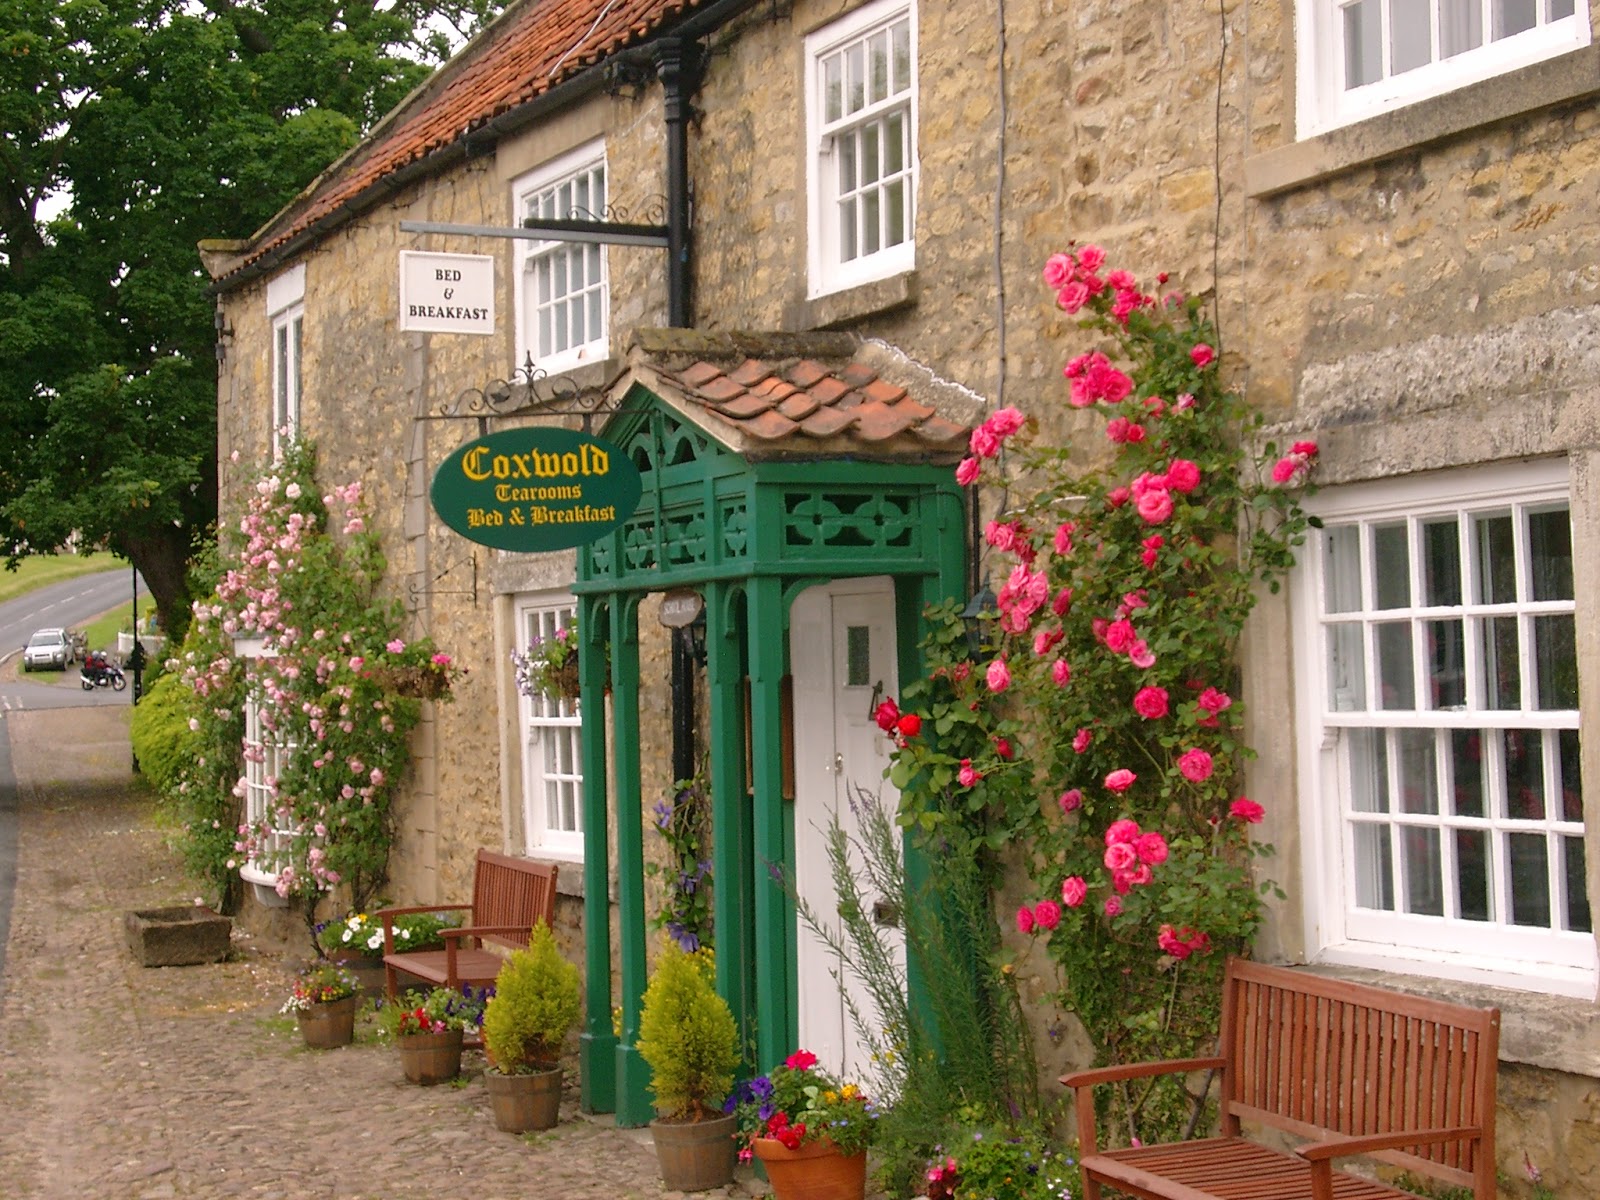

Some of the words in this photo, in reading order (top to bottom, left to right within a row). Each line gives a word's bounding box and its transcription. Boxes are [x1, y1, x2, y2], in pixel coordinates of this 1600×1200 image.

[435, 269, 461, 281] BED
[444, 288, 454, 300] &
[409, 305, 489, 320] BREAKFAST
[461, 443, 609, 481] Coxwold
[495, 484, 582, 502] Tearooms
[467, 508, 503, 529] Bed
[508, 507, 525, 526] &
[530, 505, 616, 526] Breakfast
